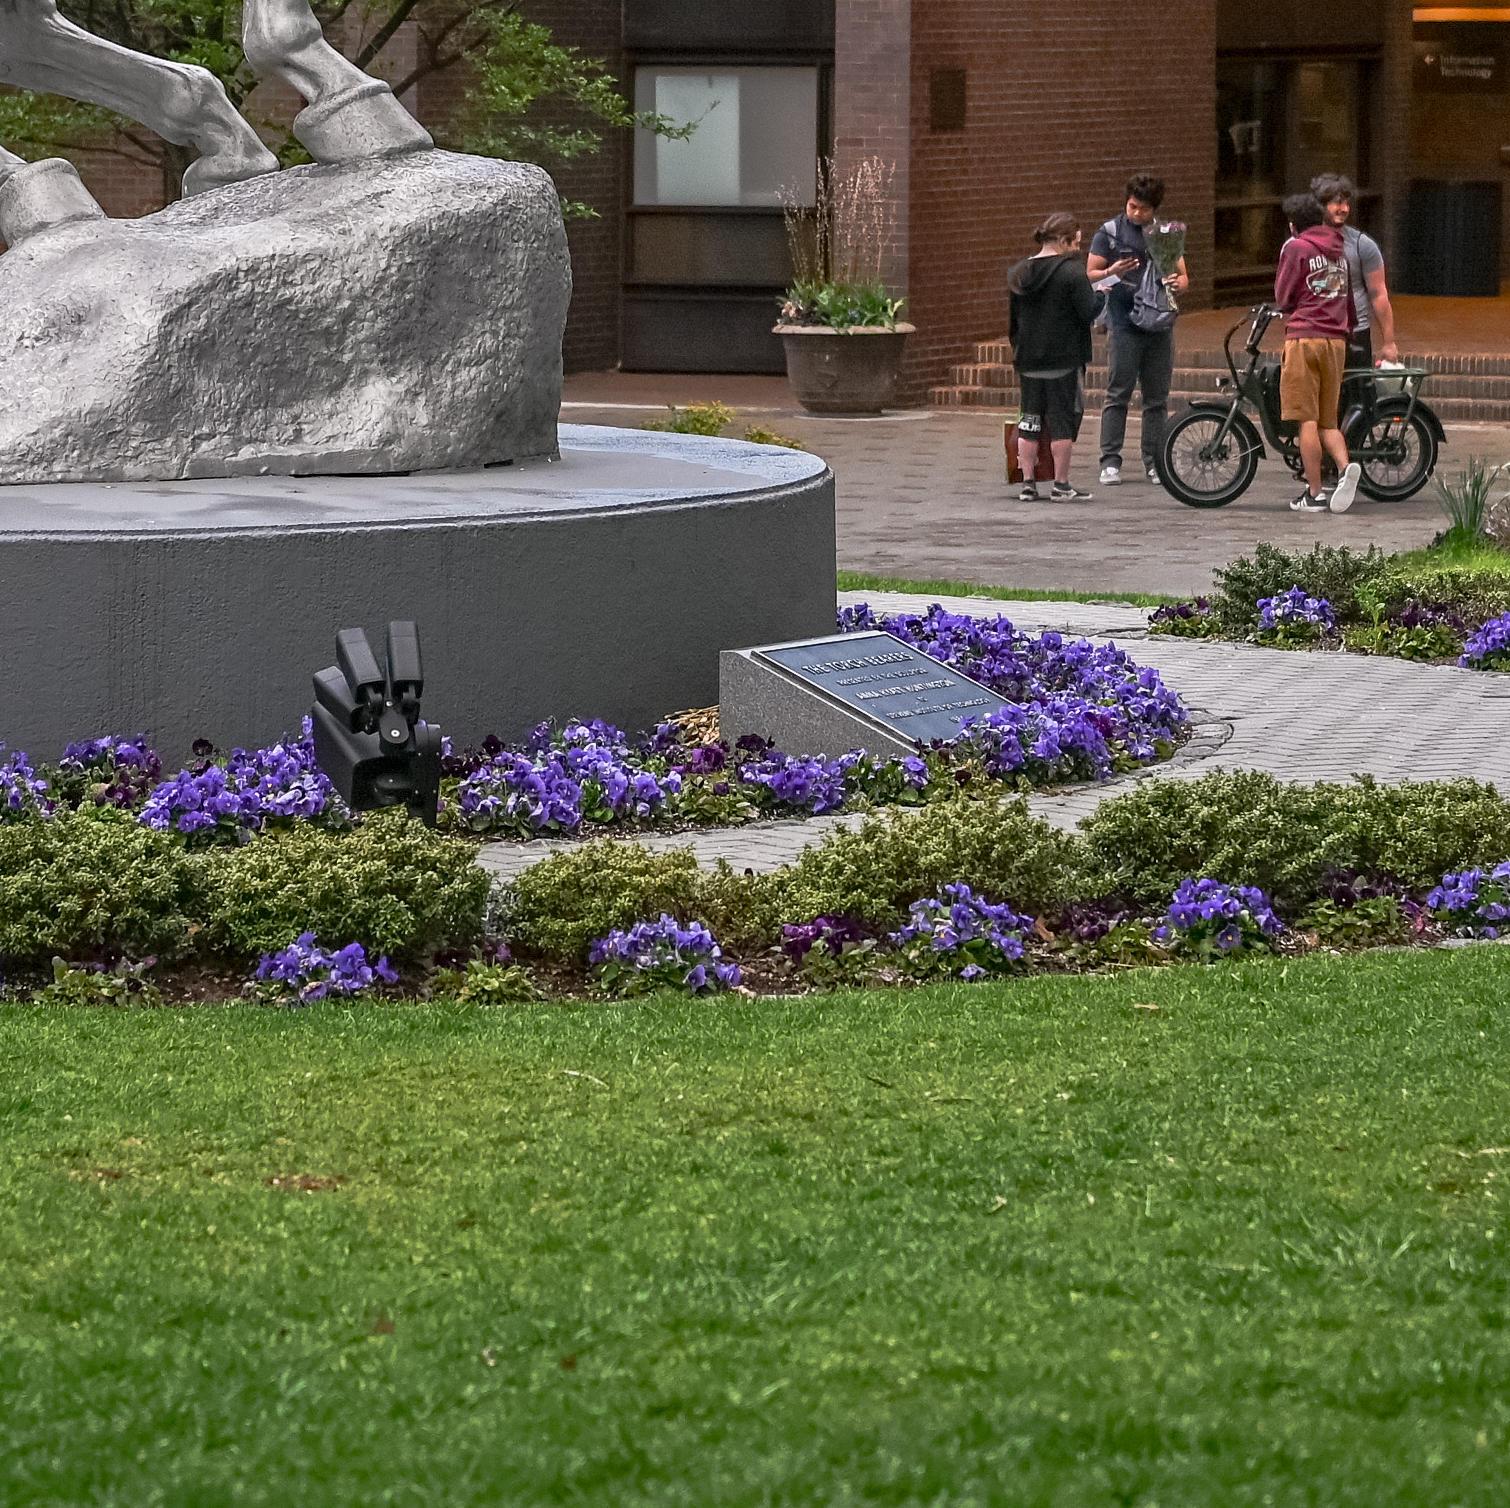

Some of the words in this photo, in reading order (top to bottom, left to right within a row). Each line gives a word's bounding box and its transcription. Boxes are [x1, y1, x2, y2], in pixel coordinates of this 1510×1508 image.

[1440, 55, 1495, 66] Information
[1440, 66, 1492, 79] Technology
[801, 663, 831, 675] THE
[824, 658, 868, 672] TORCH
[863, 651, 914, 666] BEARERS
